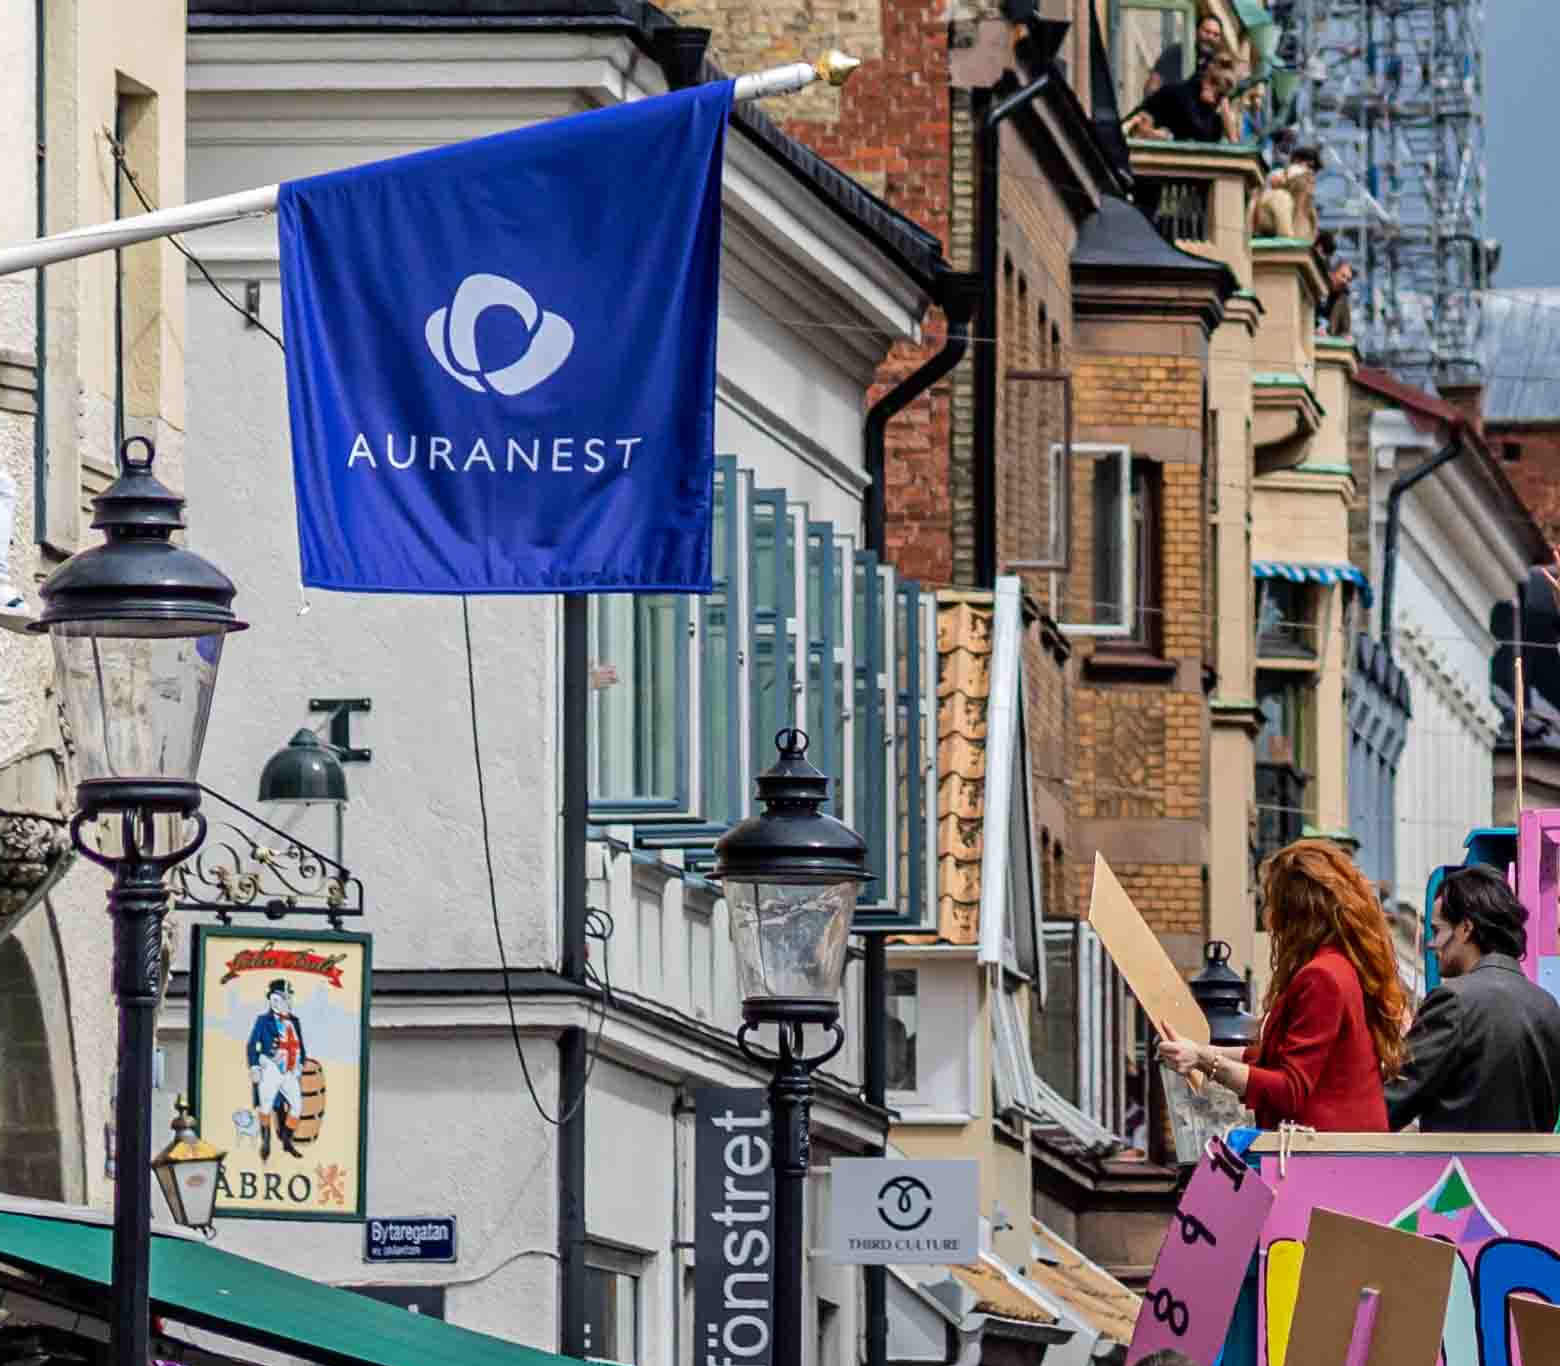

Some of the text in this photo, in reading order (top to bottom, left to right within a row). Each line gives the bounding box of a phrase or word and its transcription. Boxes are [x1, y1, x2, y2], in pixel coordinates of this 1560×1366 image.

[347, 432, 642, 473] AURANEST
[371, 1221, 449, 1245] Bytaregatan
[848, 1238, 961, 1251] THIRD CULTURE
